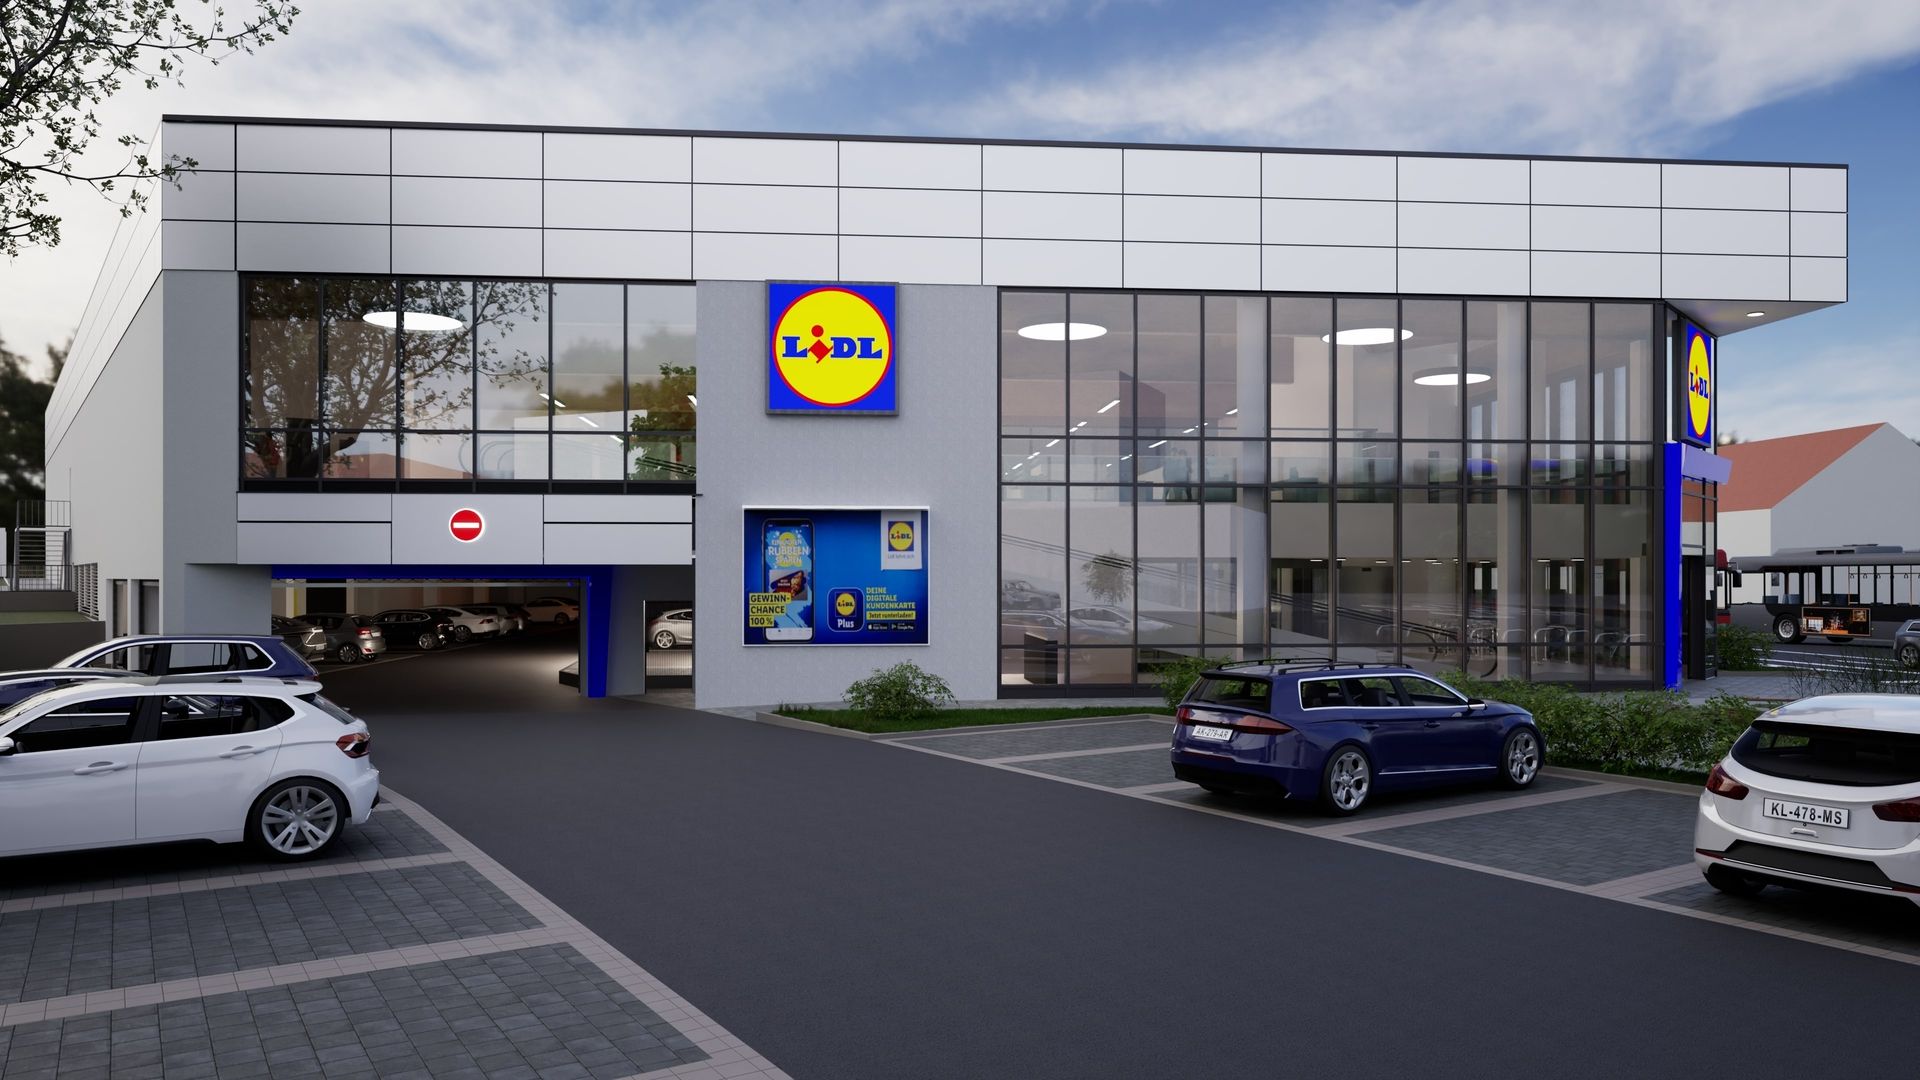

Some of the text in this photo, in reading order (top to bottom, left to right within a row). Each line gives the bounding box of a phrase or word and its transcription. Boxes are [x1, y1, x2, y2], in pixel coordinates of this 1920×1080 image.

[768, 546, 809, 556] RUBBELN
[750, 594, 790, 603] GEWINN-
[750, 605, 785, 614] CHANCE
[750, 617, 773, 626] 100 %
[837, 618, 855, 628] Plus
[1771, 802, 1842, 825] KL-478-MS
